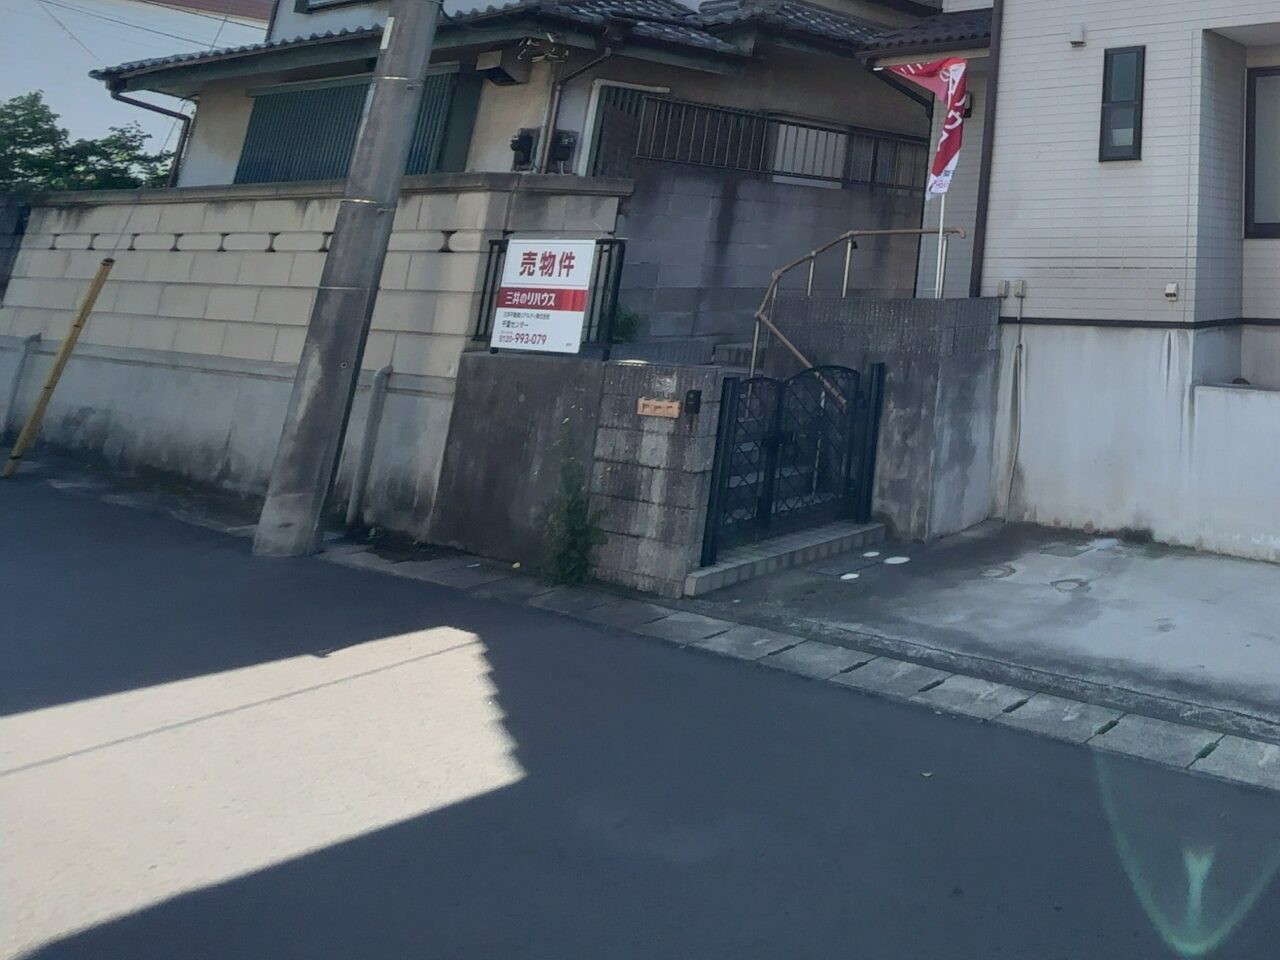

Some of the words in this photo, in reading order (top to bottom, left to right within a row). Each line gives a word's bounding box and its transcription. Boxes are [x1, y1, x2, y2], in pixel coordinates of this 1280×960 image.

[519, 251, 576, 278] 売物件
[504, 291, 556, 306] 三井のリハウス
